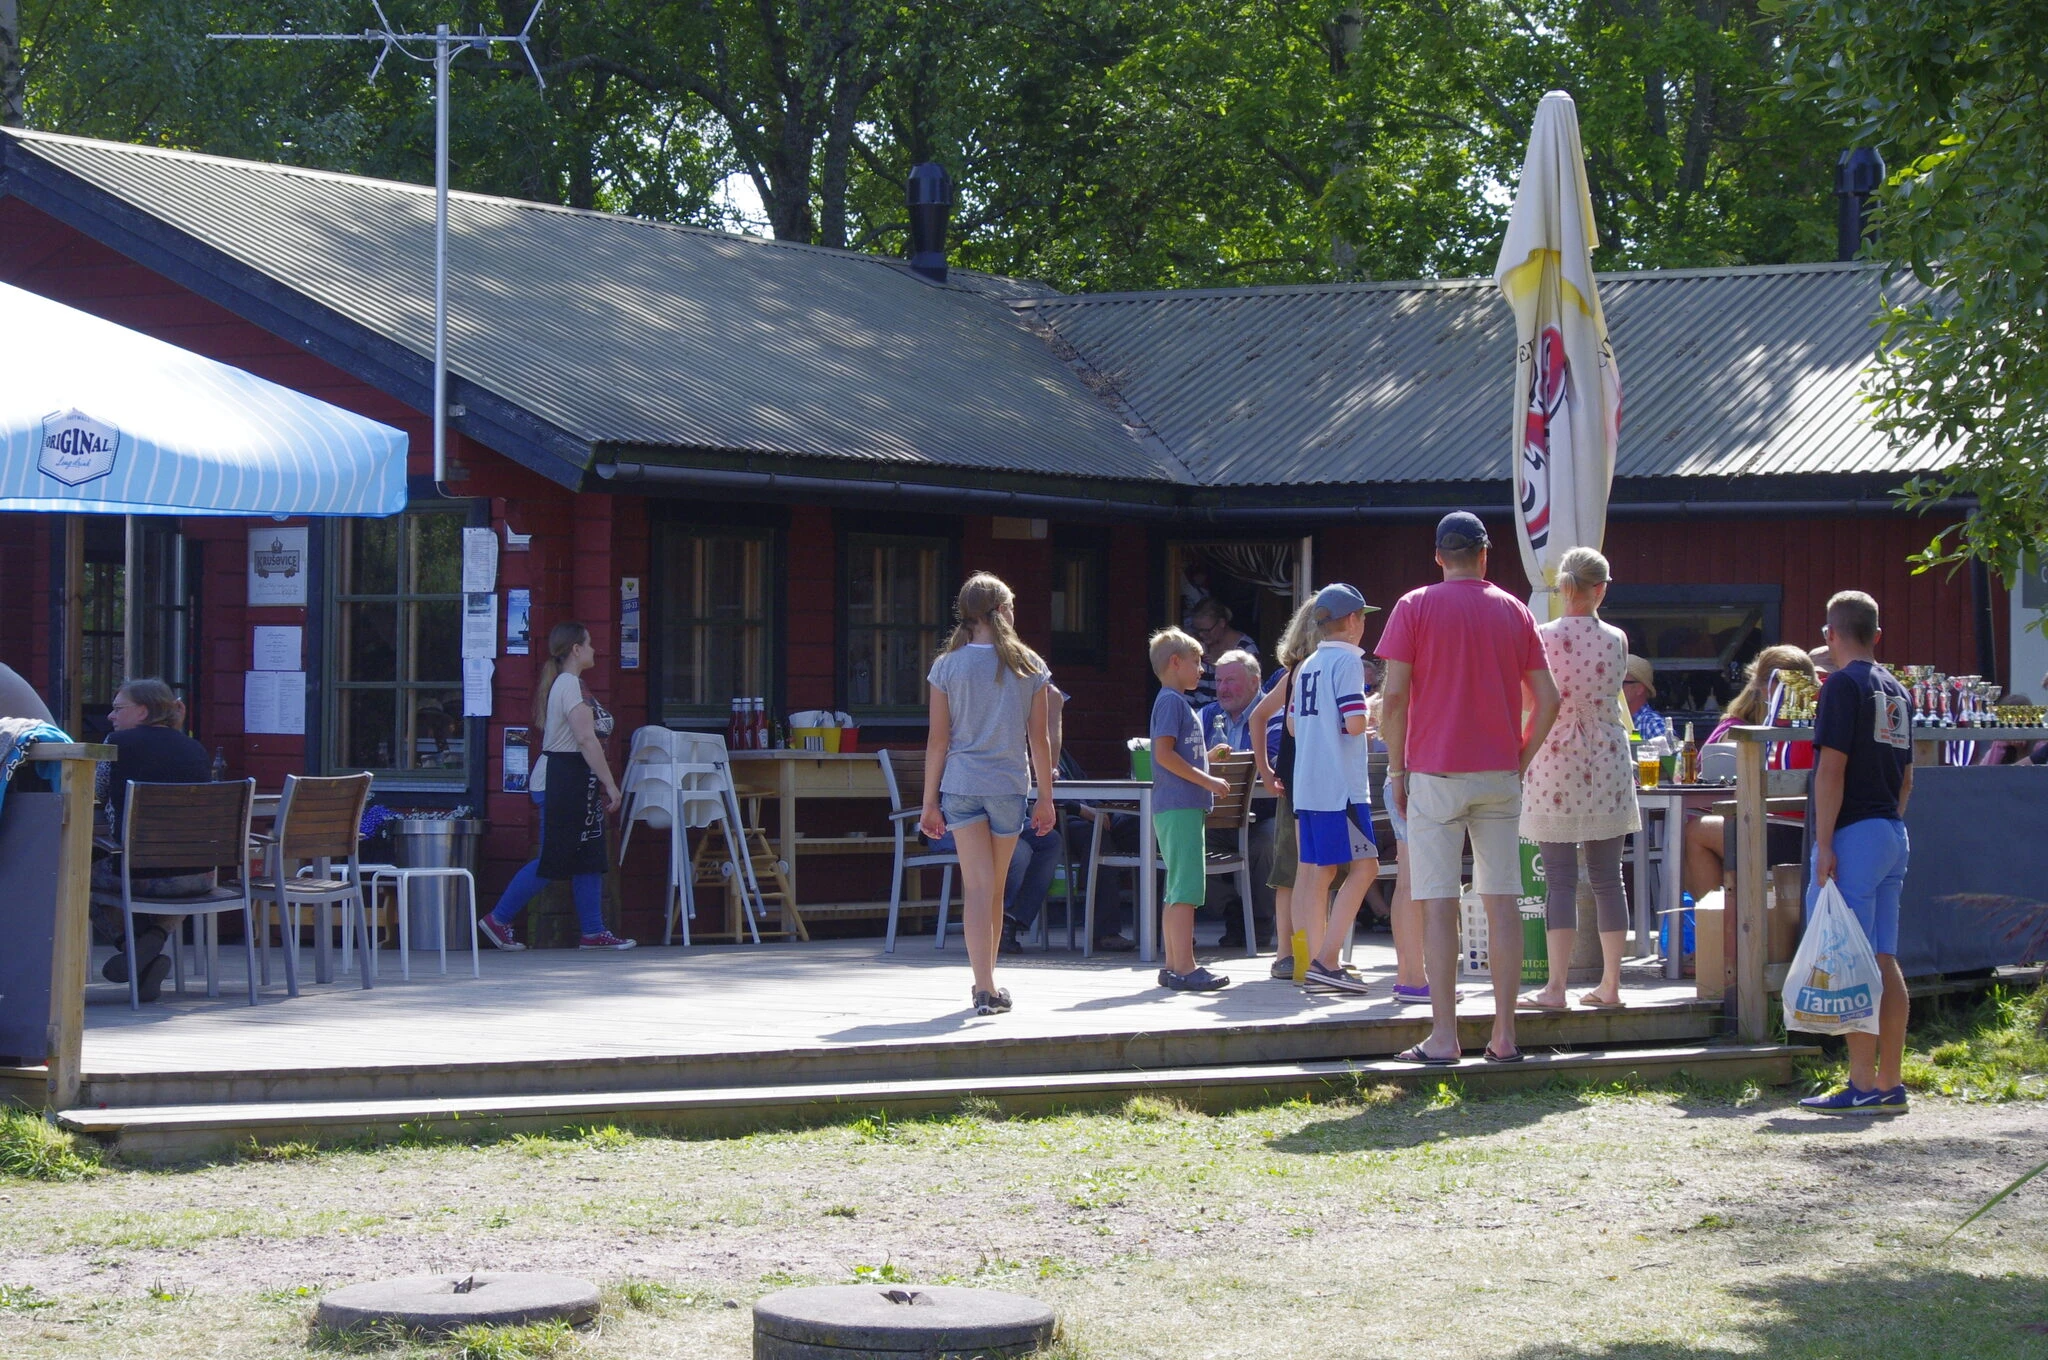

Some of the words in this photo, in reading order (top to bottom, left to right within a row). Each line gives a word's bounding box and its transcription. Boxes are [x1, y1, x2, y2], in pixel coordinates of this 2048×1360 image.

[46, 428, 109, 455] ORIGINAL
[1300, 670, 1321, 717] H
[1802, 989, 1869, 1013] Tarmo
